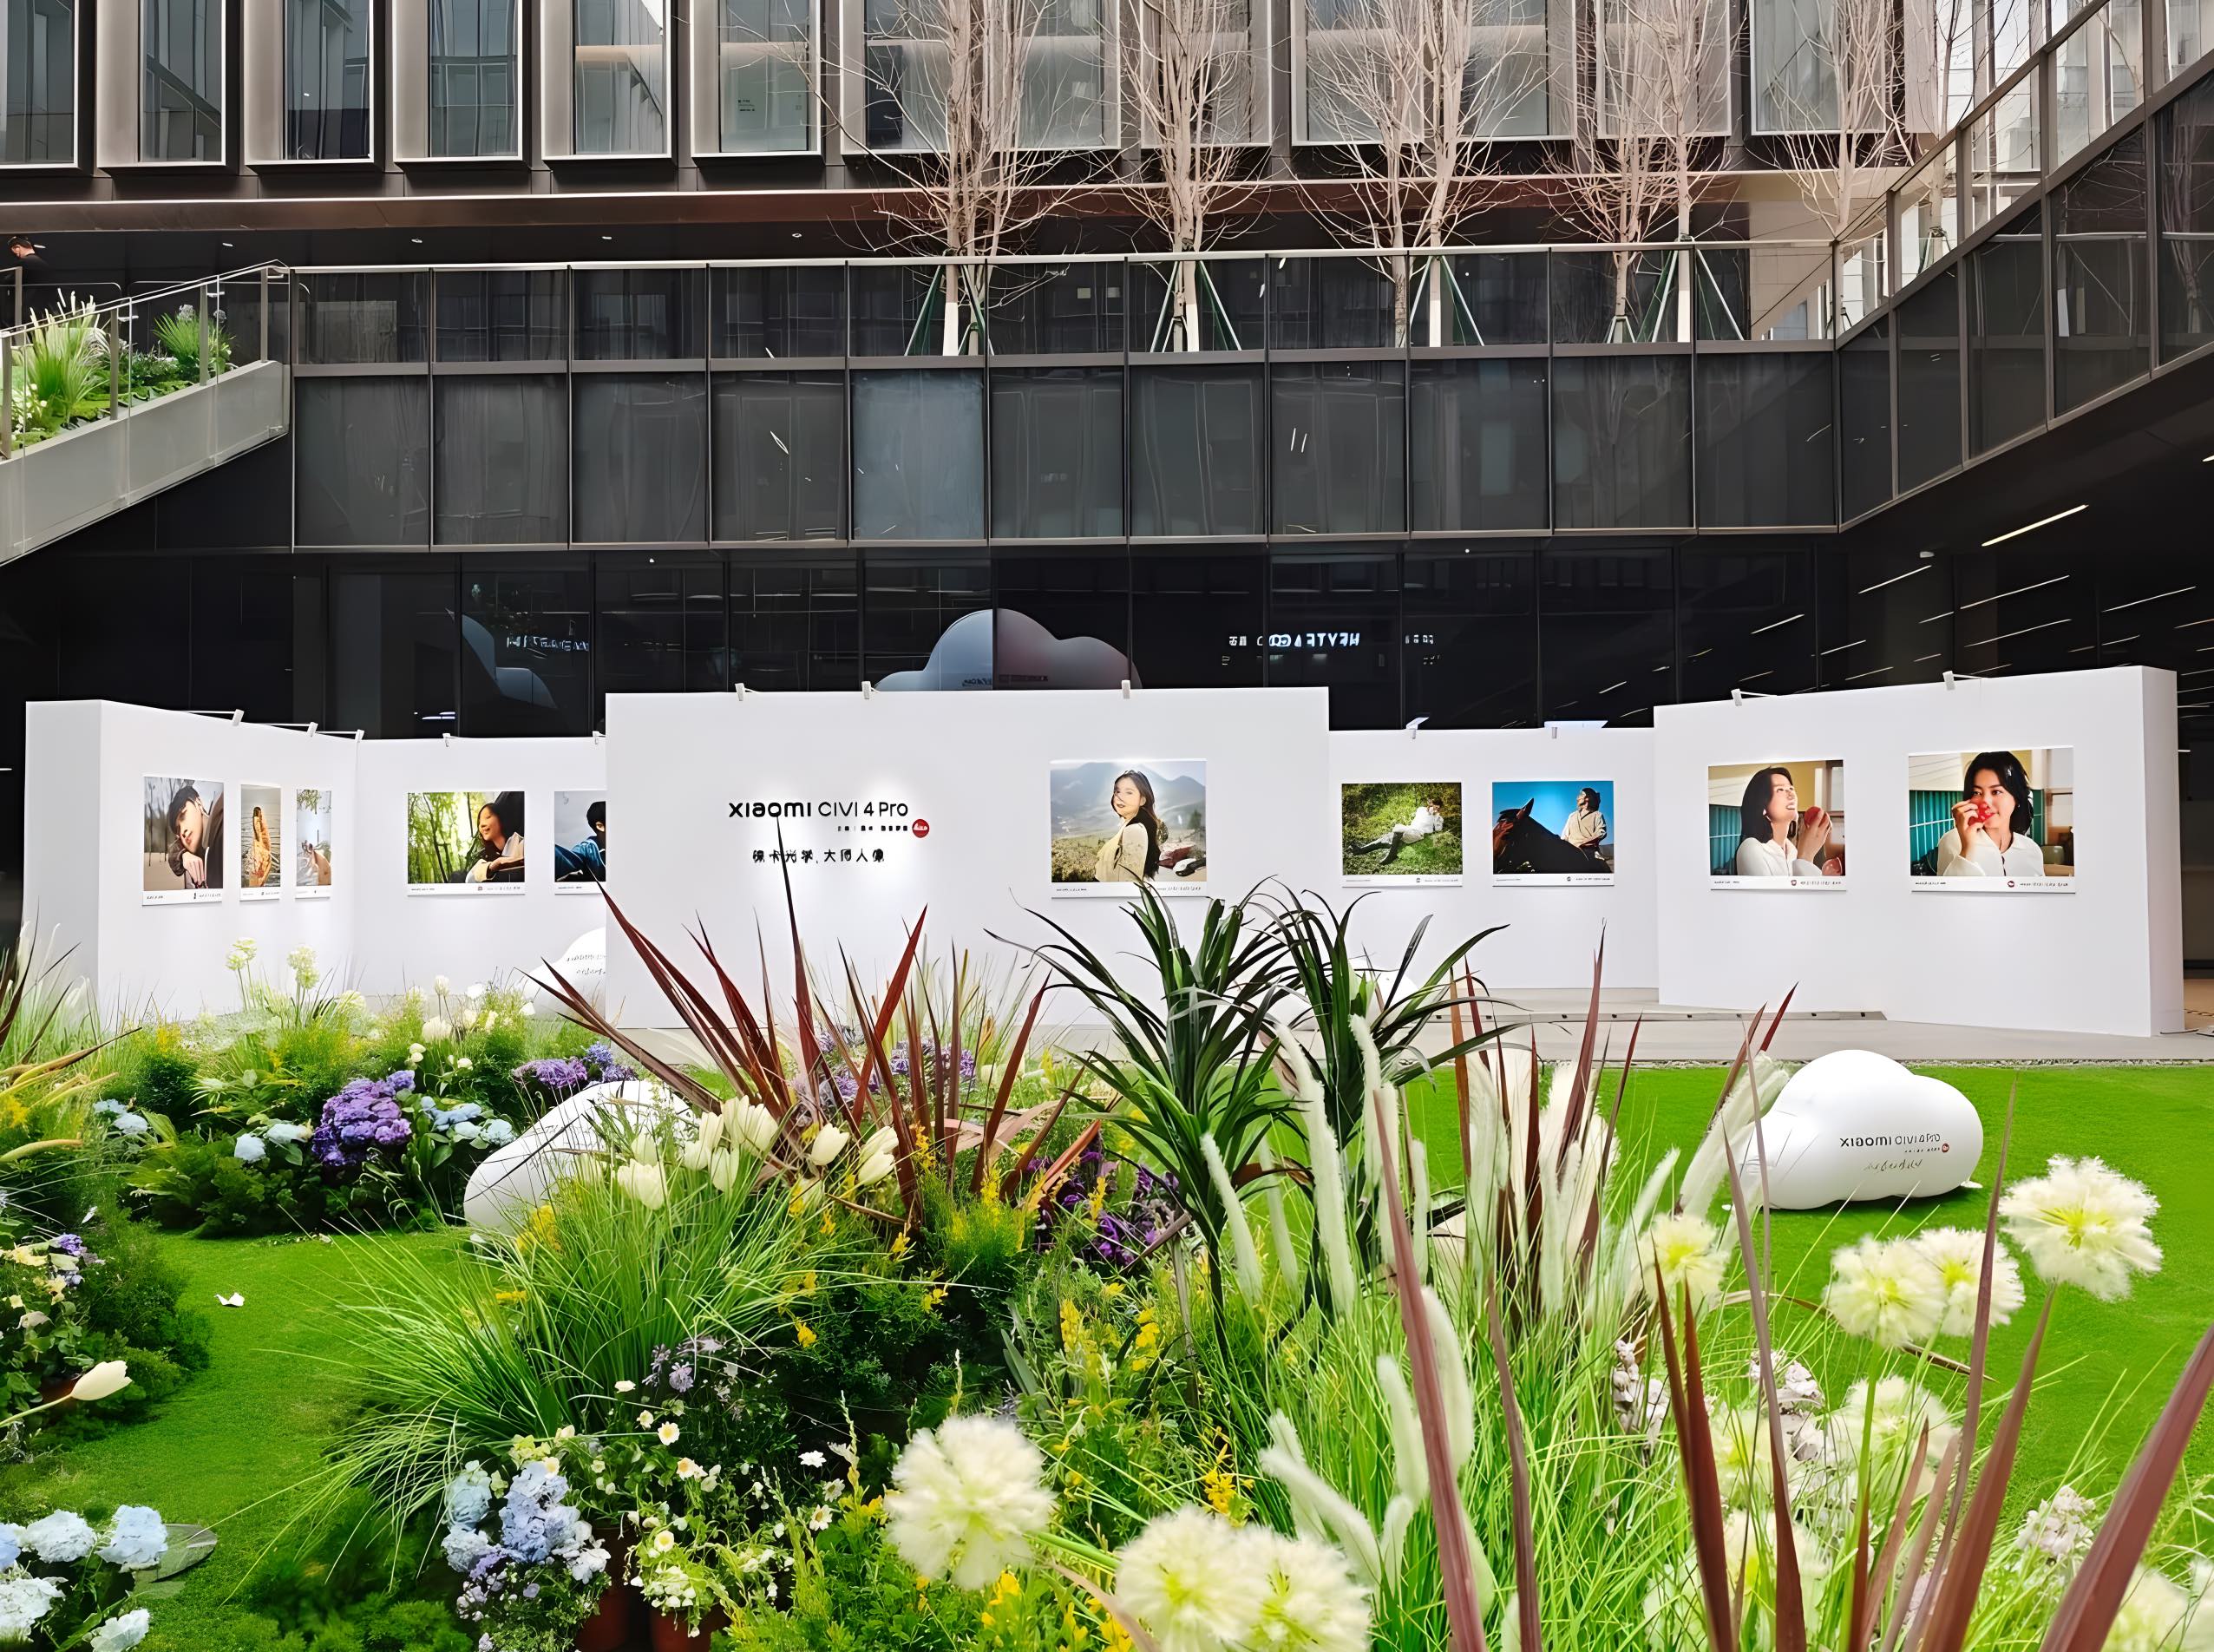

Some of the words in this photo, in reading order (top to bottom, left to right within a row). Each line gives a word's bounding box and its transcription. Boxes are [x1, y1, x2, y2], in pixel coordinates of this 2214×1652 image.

[729, 802, 811, 817] xiaomi
[818, 802, 858, 816] CIVI
[863, 802, 874, 816] 4
[879, 802, 908, 816] Pro
